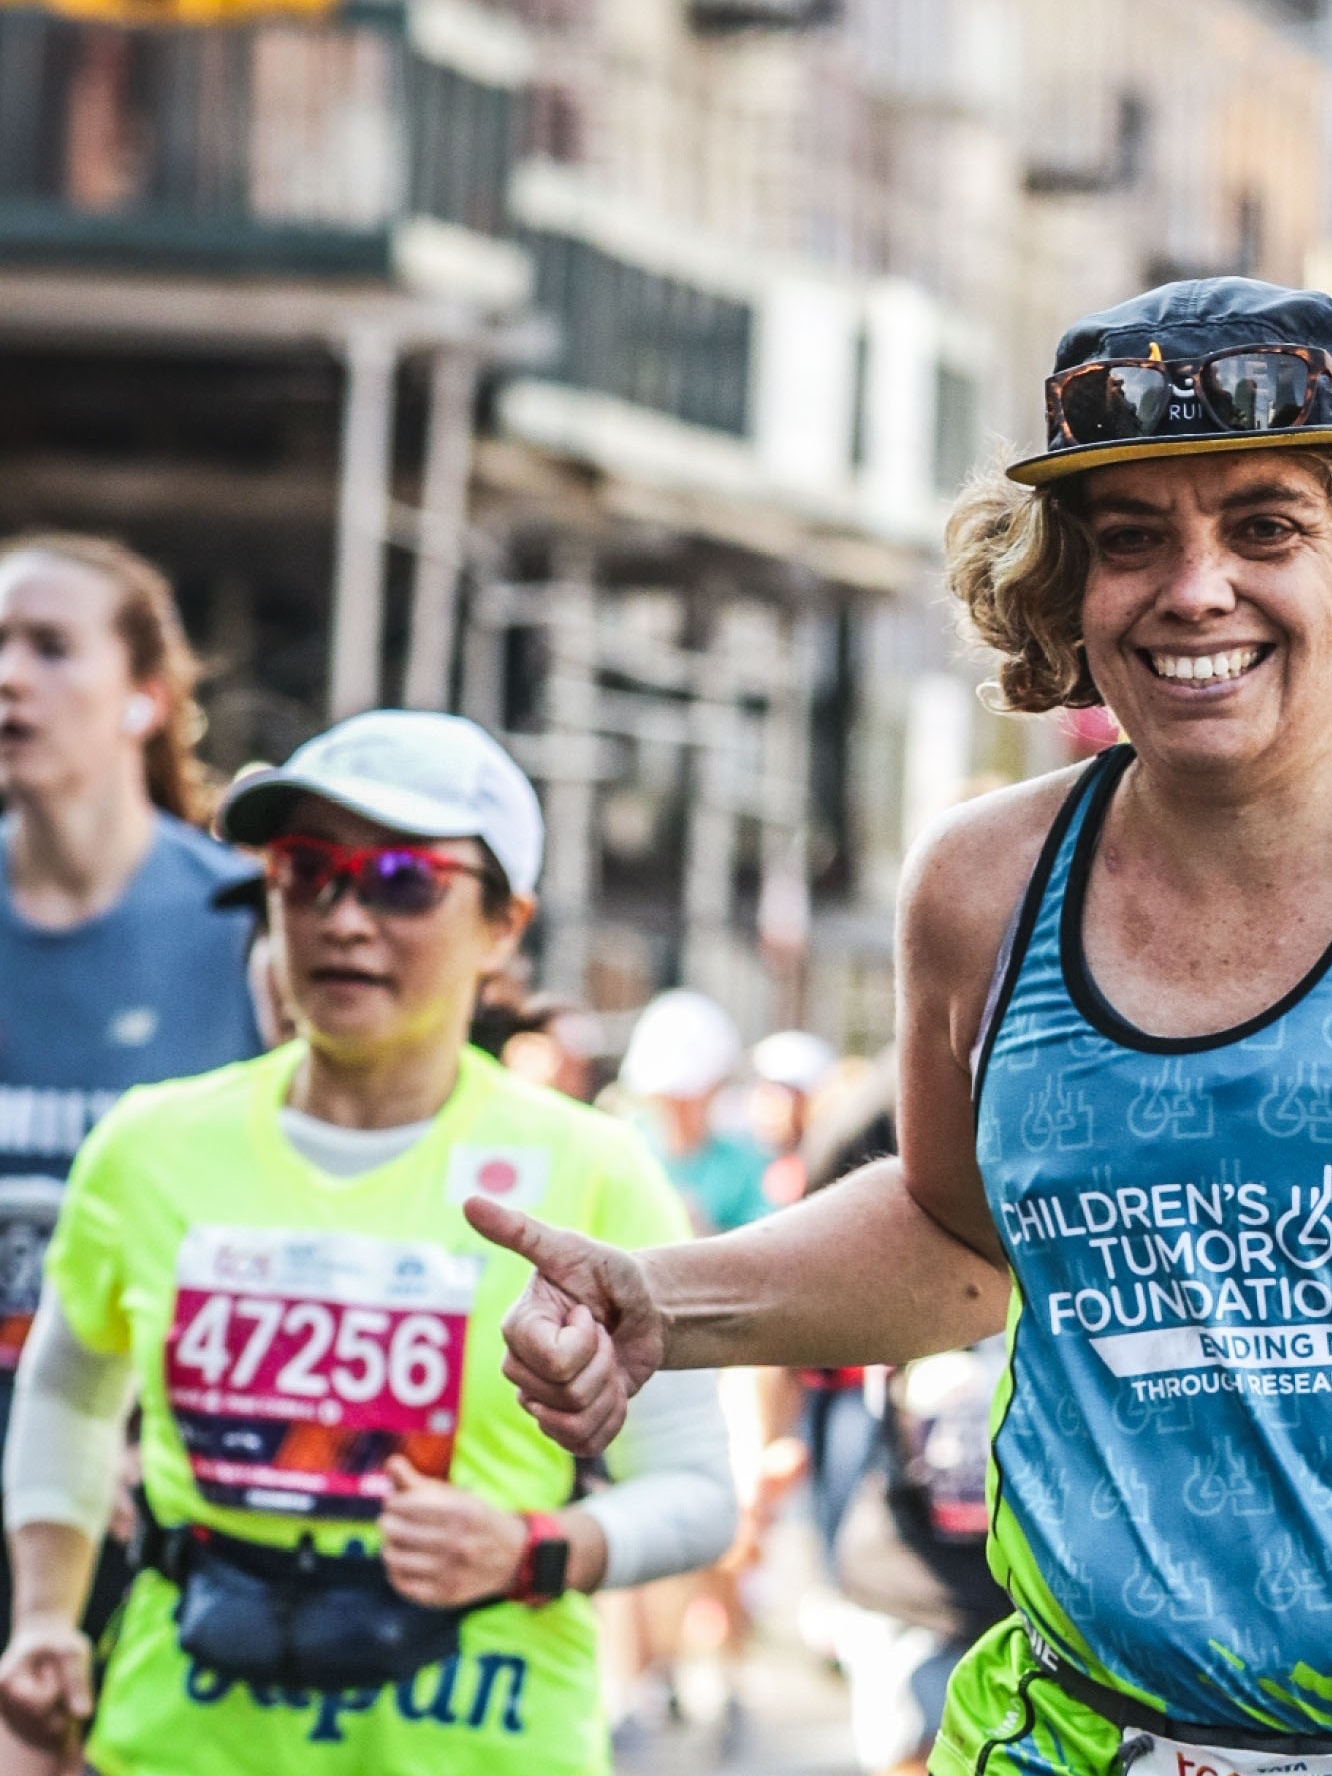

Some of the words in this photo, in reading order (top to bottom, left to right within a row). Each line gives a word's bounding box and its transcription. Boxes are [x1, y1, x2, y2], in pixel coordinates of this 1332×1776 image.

[1001, 1182, 1272, 1247] CHILDREN'S
[1089, 1228, 1277, 1280] TUMOR
[175, 1296, 450, 1408] 47256
[1200, 1331, 1315, 1360] ENDING
